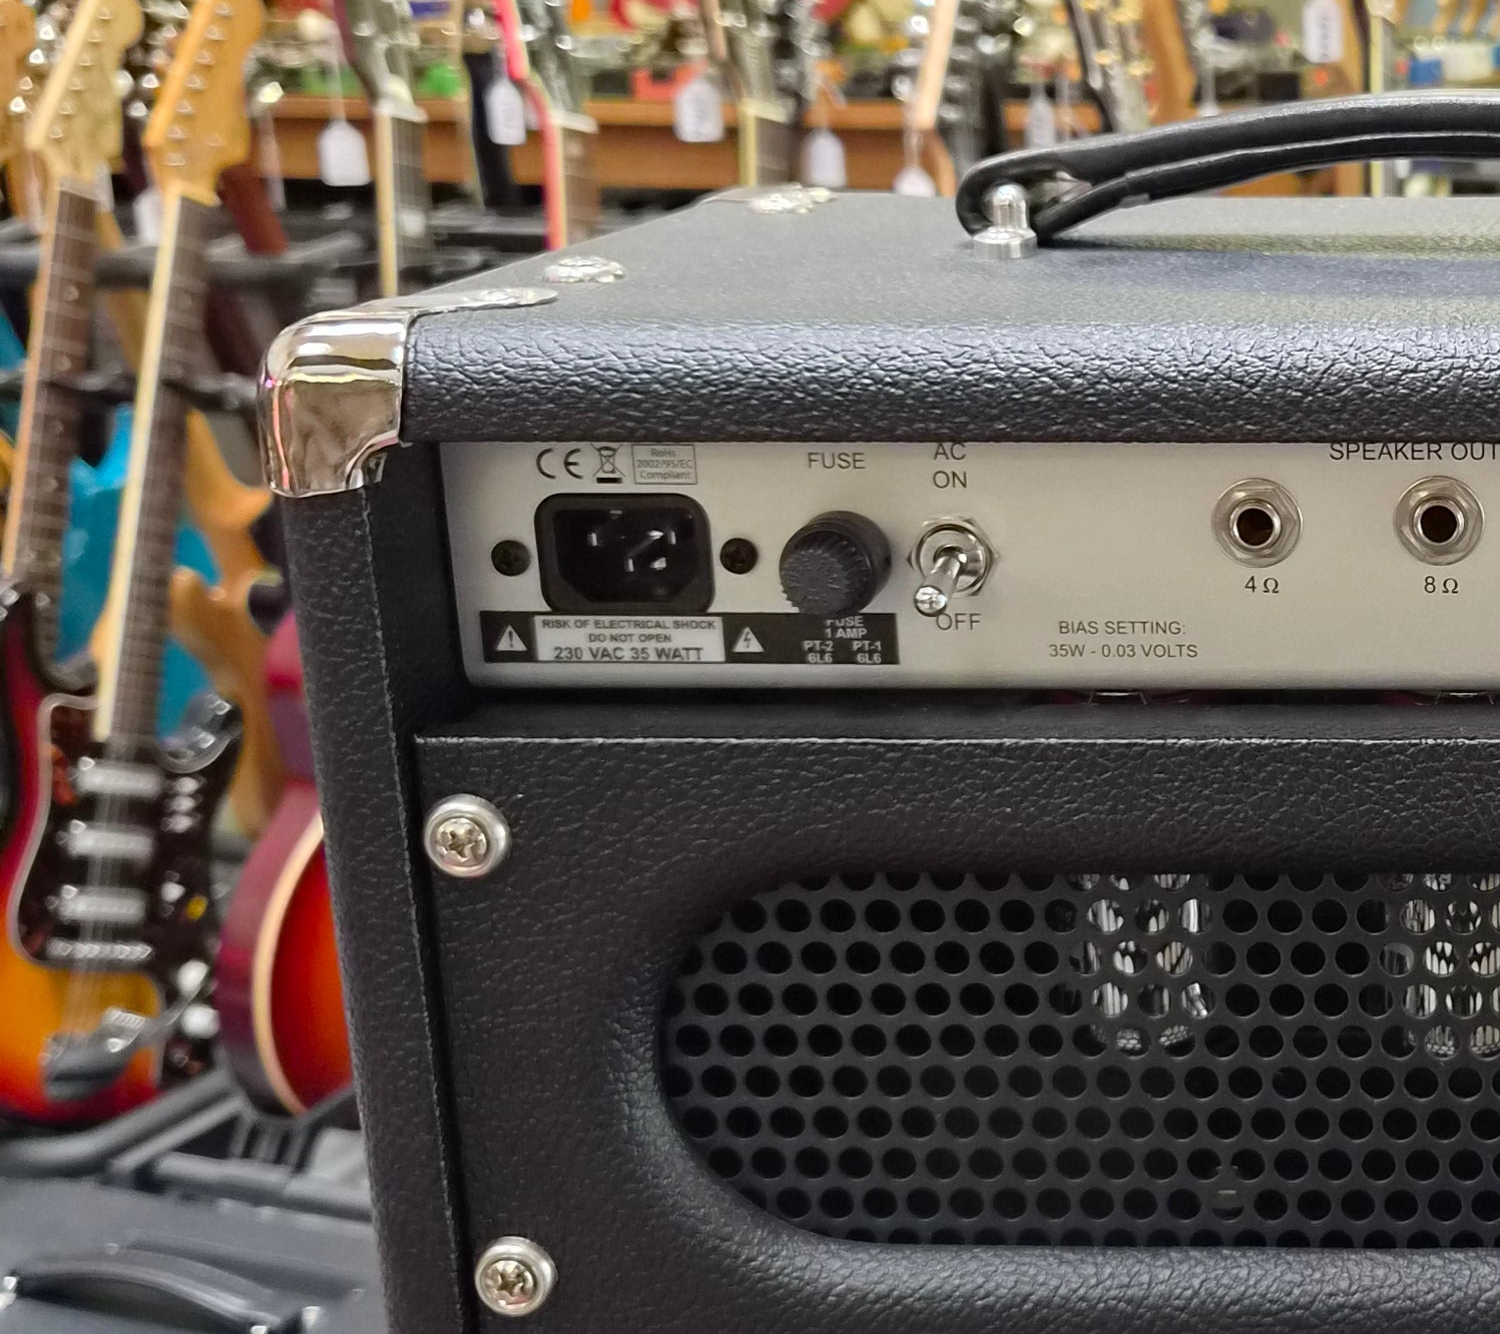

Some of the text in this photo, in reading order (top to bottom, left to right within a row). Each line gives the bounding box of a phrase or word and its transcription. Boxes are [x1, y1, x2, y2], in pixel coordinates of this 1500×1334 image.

[933, 441, 967, 461] AC
[1329, 442, 1443, 461] SPEAKER
[807, 451, 866, 470] FUSE
[639, 469, 691, 481] Compliant
[932, 470, 968, 489] ON
[1244, 576, 1257, 594] 4
[1423, 576, 1436, 594] 8
[542, 619, 716, 629] RISK OF ELECTRICAL SHOCK
[936, 612, 981, 631] OFF
[1058, 620, 1187, 635] BIAS SETTING:
[588, 633, 672, 643] DO NOT OPEN
[825, 628, 868, 639] 1 AMP
[803, 640, 834, 652] PT-2
[852, 640, 882, 651] PT-1
[1049, 644, 1086, 658] 35W
[1101, 644, 1136, 658] 0.03
[1140, 644, 1198, 658] VOLTS
[554, 646, 704, 661] 230 VAC 35 WATT
[808, 653, 833, 664] 6L6
[856, 653, 882, 664] 6L6
